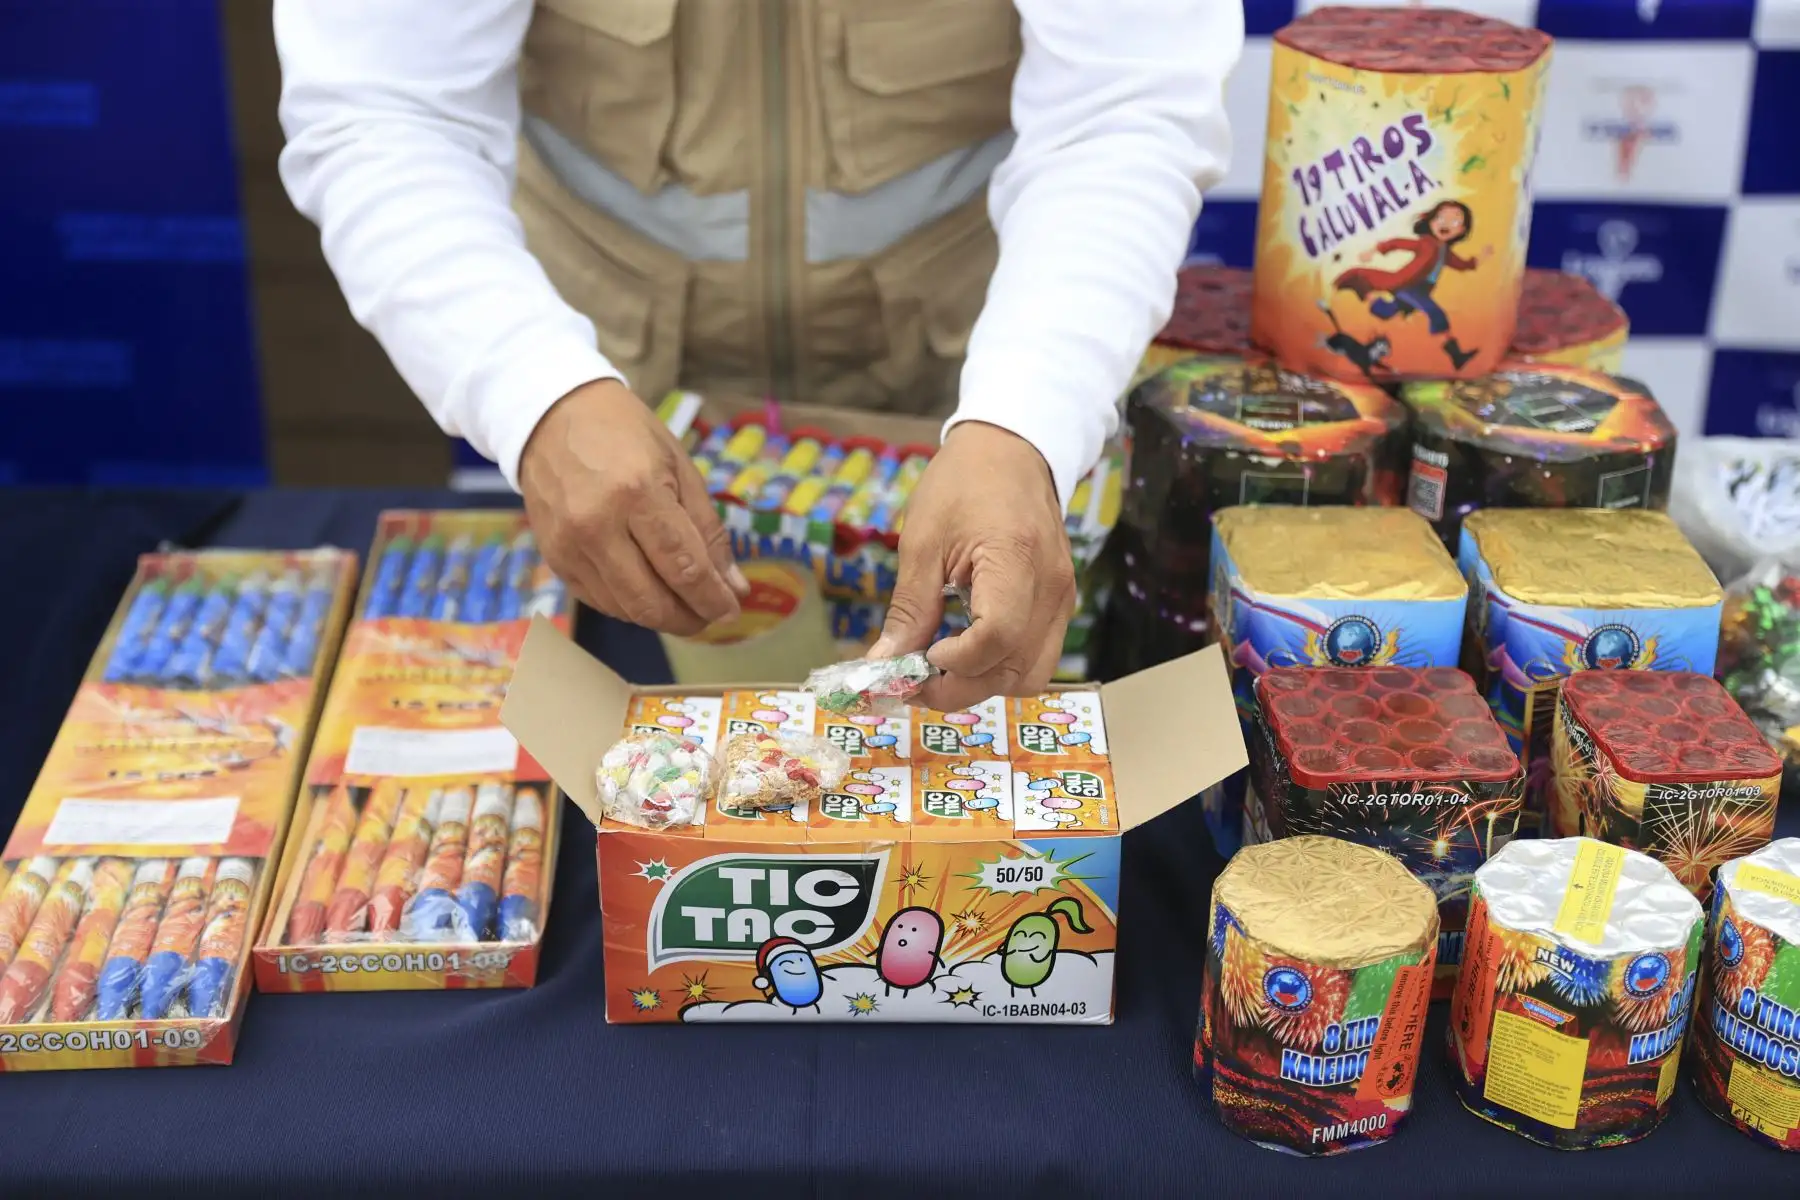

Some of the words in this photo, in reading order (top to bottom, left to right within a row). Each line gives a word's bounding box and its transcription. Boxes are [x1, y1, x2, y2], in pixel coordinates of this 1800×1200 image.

[845, 729, 861, 752] TAC
[925, 726, 942, 747] TIC
[942, 728, 959, 752] TAC
[1022, 725, 1039, 746] TIC
[1039, 728, 1056, 752] TAC
[1066, 773, 1083, 794] TAC
[1082, 778, 1099, 797] TIC
[1658, 786, 1761, 801] IC-2GTOR01-03
[825, 794, 842, 814] TIC
[841, 797, 859, 818] TAC
[927, 792, 945, 812] TIC
[944, 794, 961, 816] TAC
[1340, 792, 1469, 807] IC-2GTOR01-04
[996, 866, 1043, 883] 50/50
[718, 866, 860, 907] TIC
[681, 905, 835, 945] TAC
[276, 952, 512, 974] IC-2CCOH01-09
[1537, 948, 1576, 974] NEW
[1395, 970, 1410, 998] remove
[982, 1002, 1087, 1017] IC-1BABN04-03
[1738, 986, 1757, 1020] 8
[1323, 1021, 1341, 1054] 8
[1379, 1017, 1396, 1041] before
[1399, 1014, 1420, 1053] HERE
[1373, 1043, 1387, 1061] light
[1311, 1113, 1387, 1144] FMM4000
